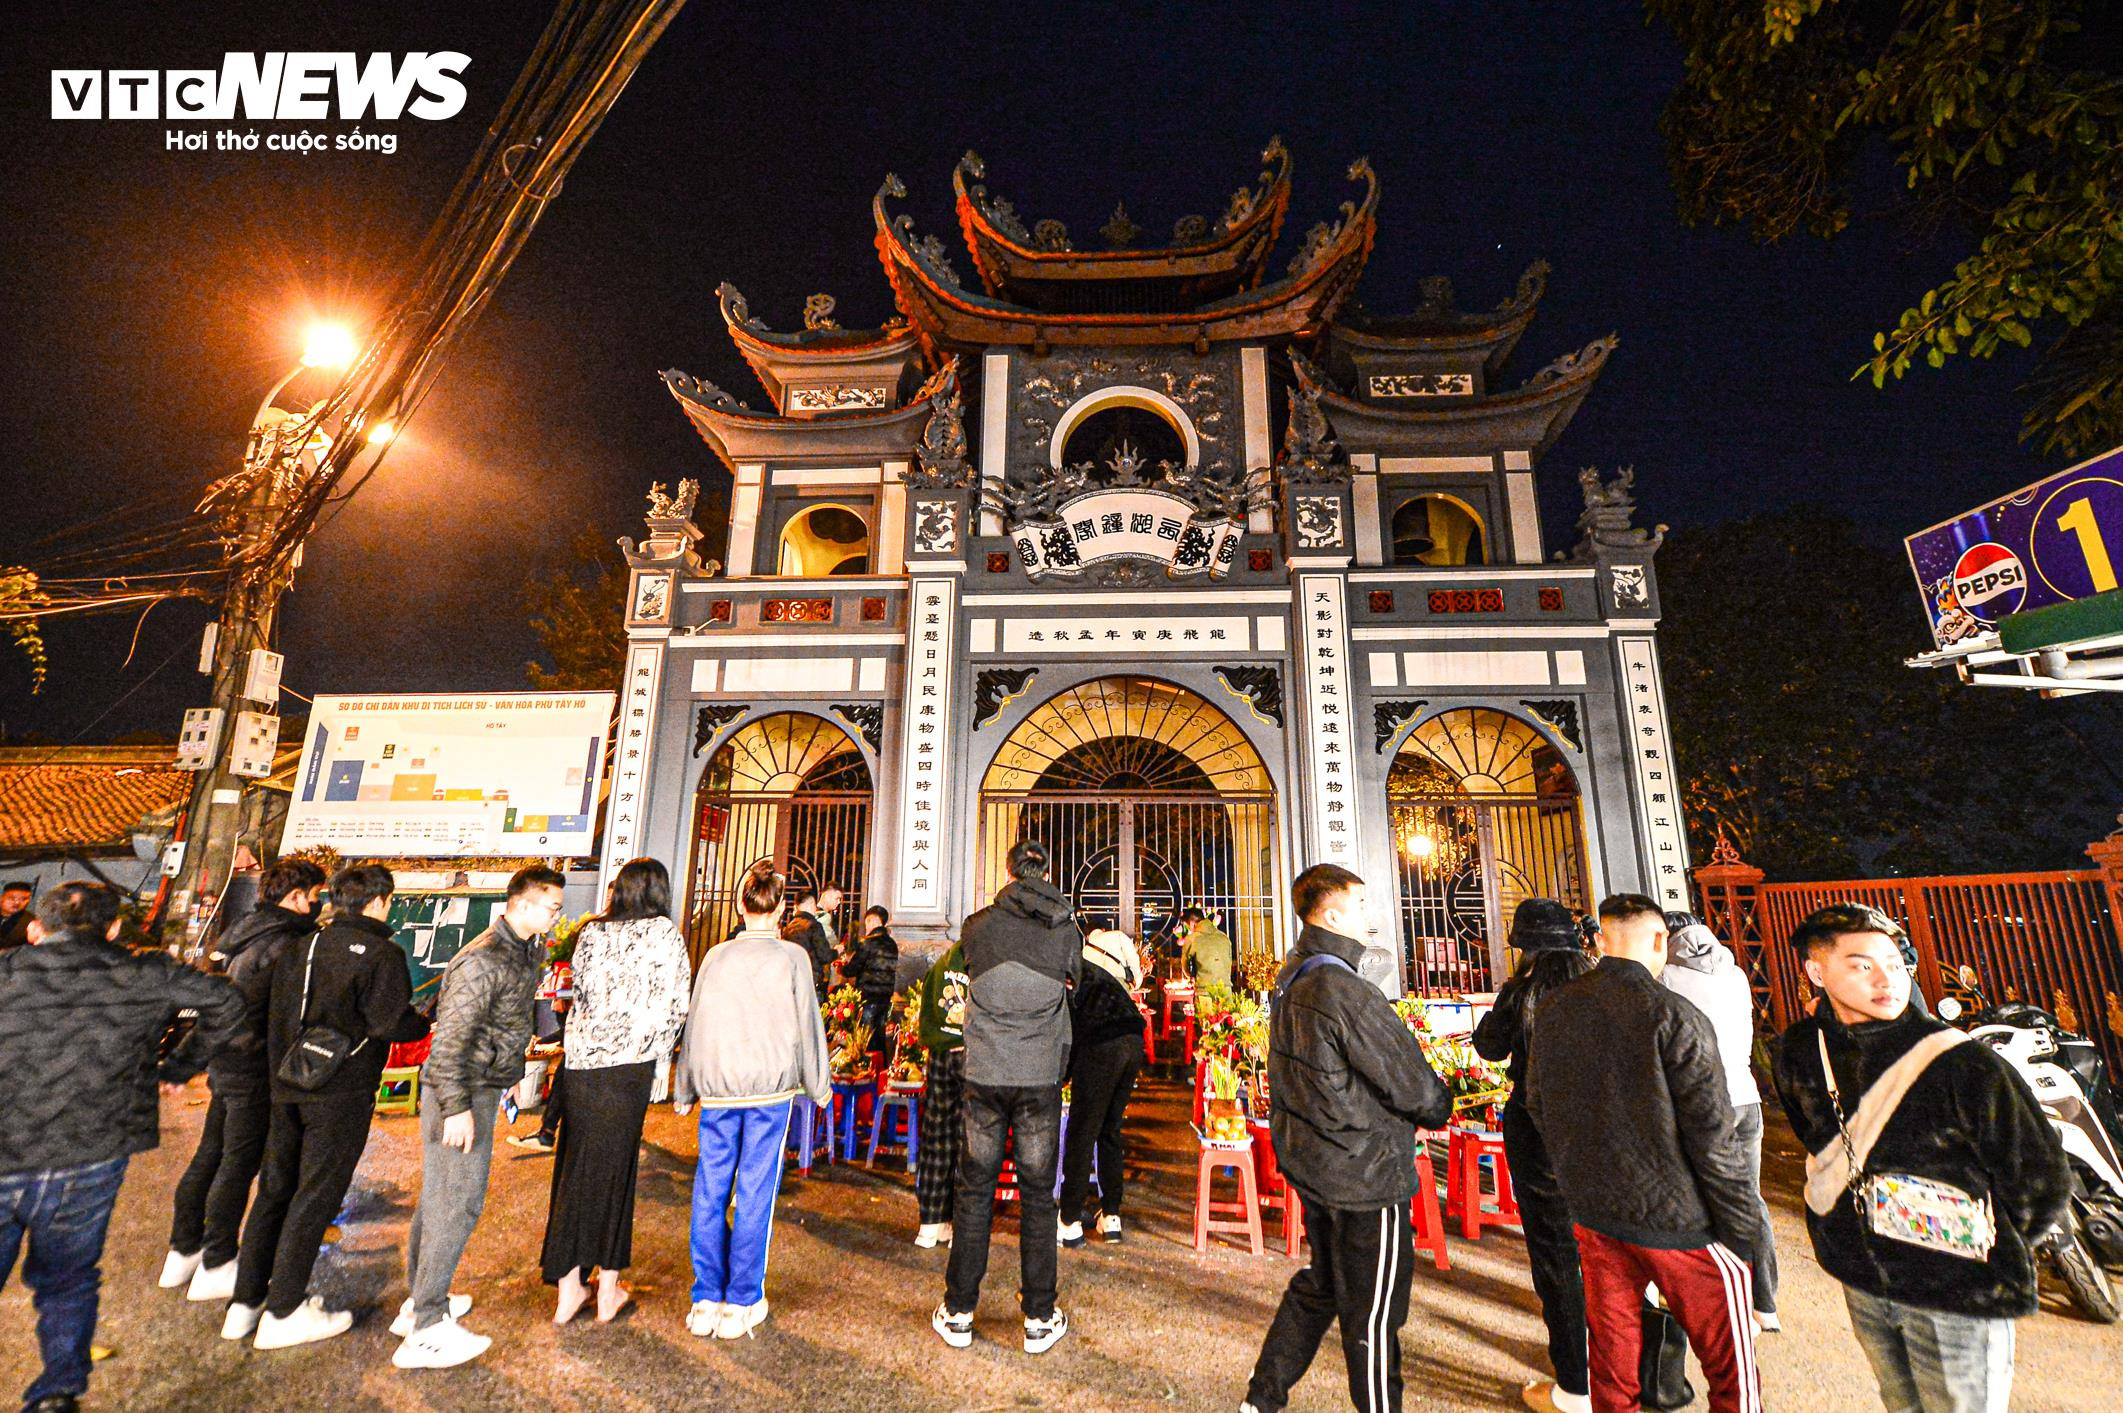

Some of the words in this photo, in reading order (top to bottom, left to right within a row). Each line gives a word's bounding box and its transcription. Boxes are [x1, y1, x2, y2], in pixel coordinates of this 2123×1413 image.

[2056, 497, 2119, 593] 1
[1957, 565, 2023, 600] PEPSI
[401, 701, 420, 710] KHU
[421, 701, 431, 710] DI
